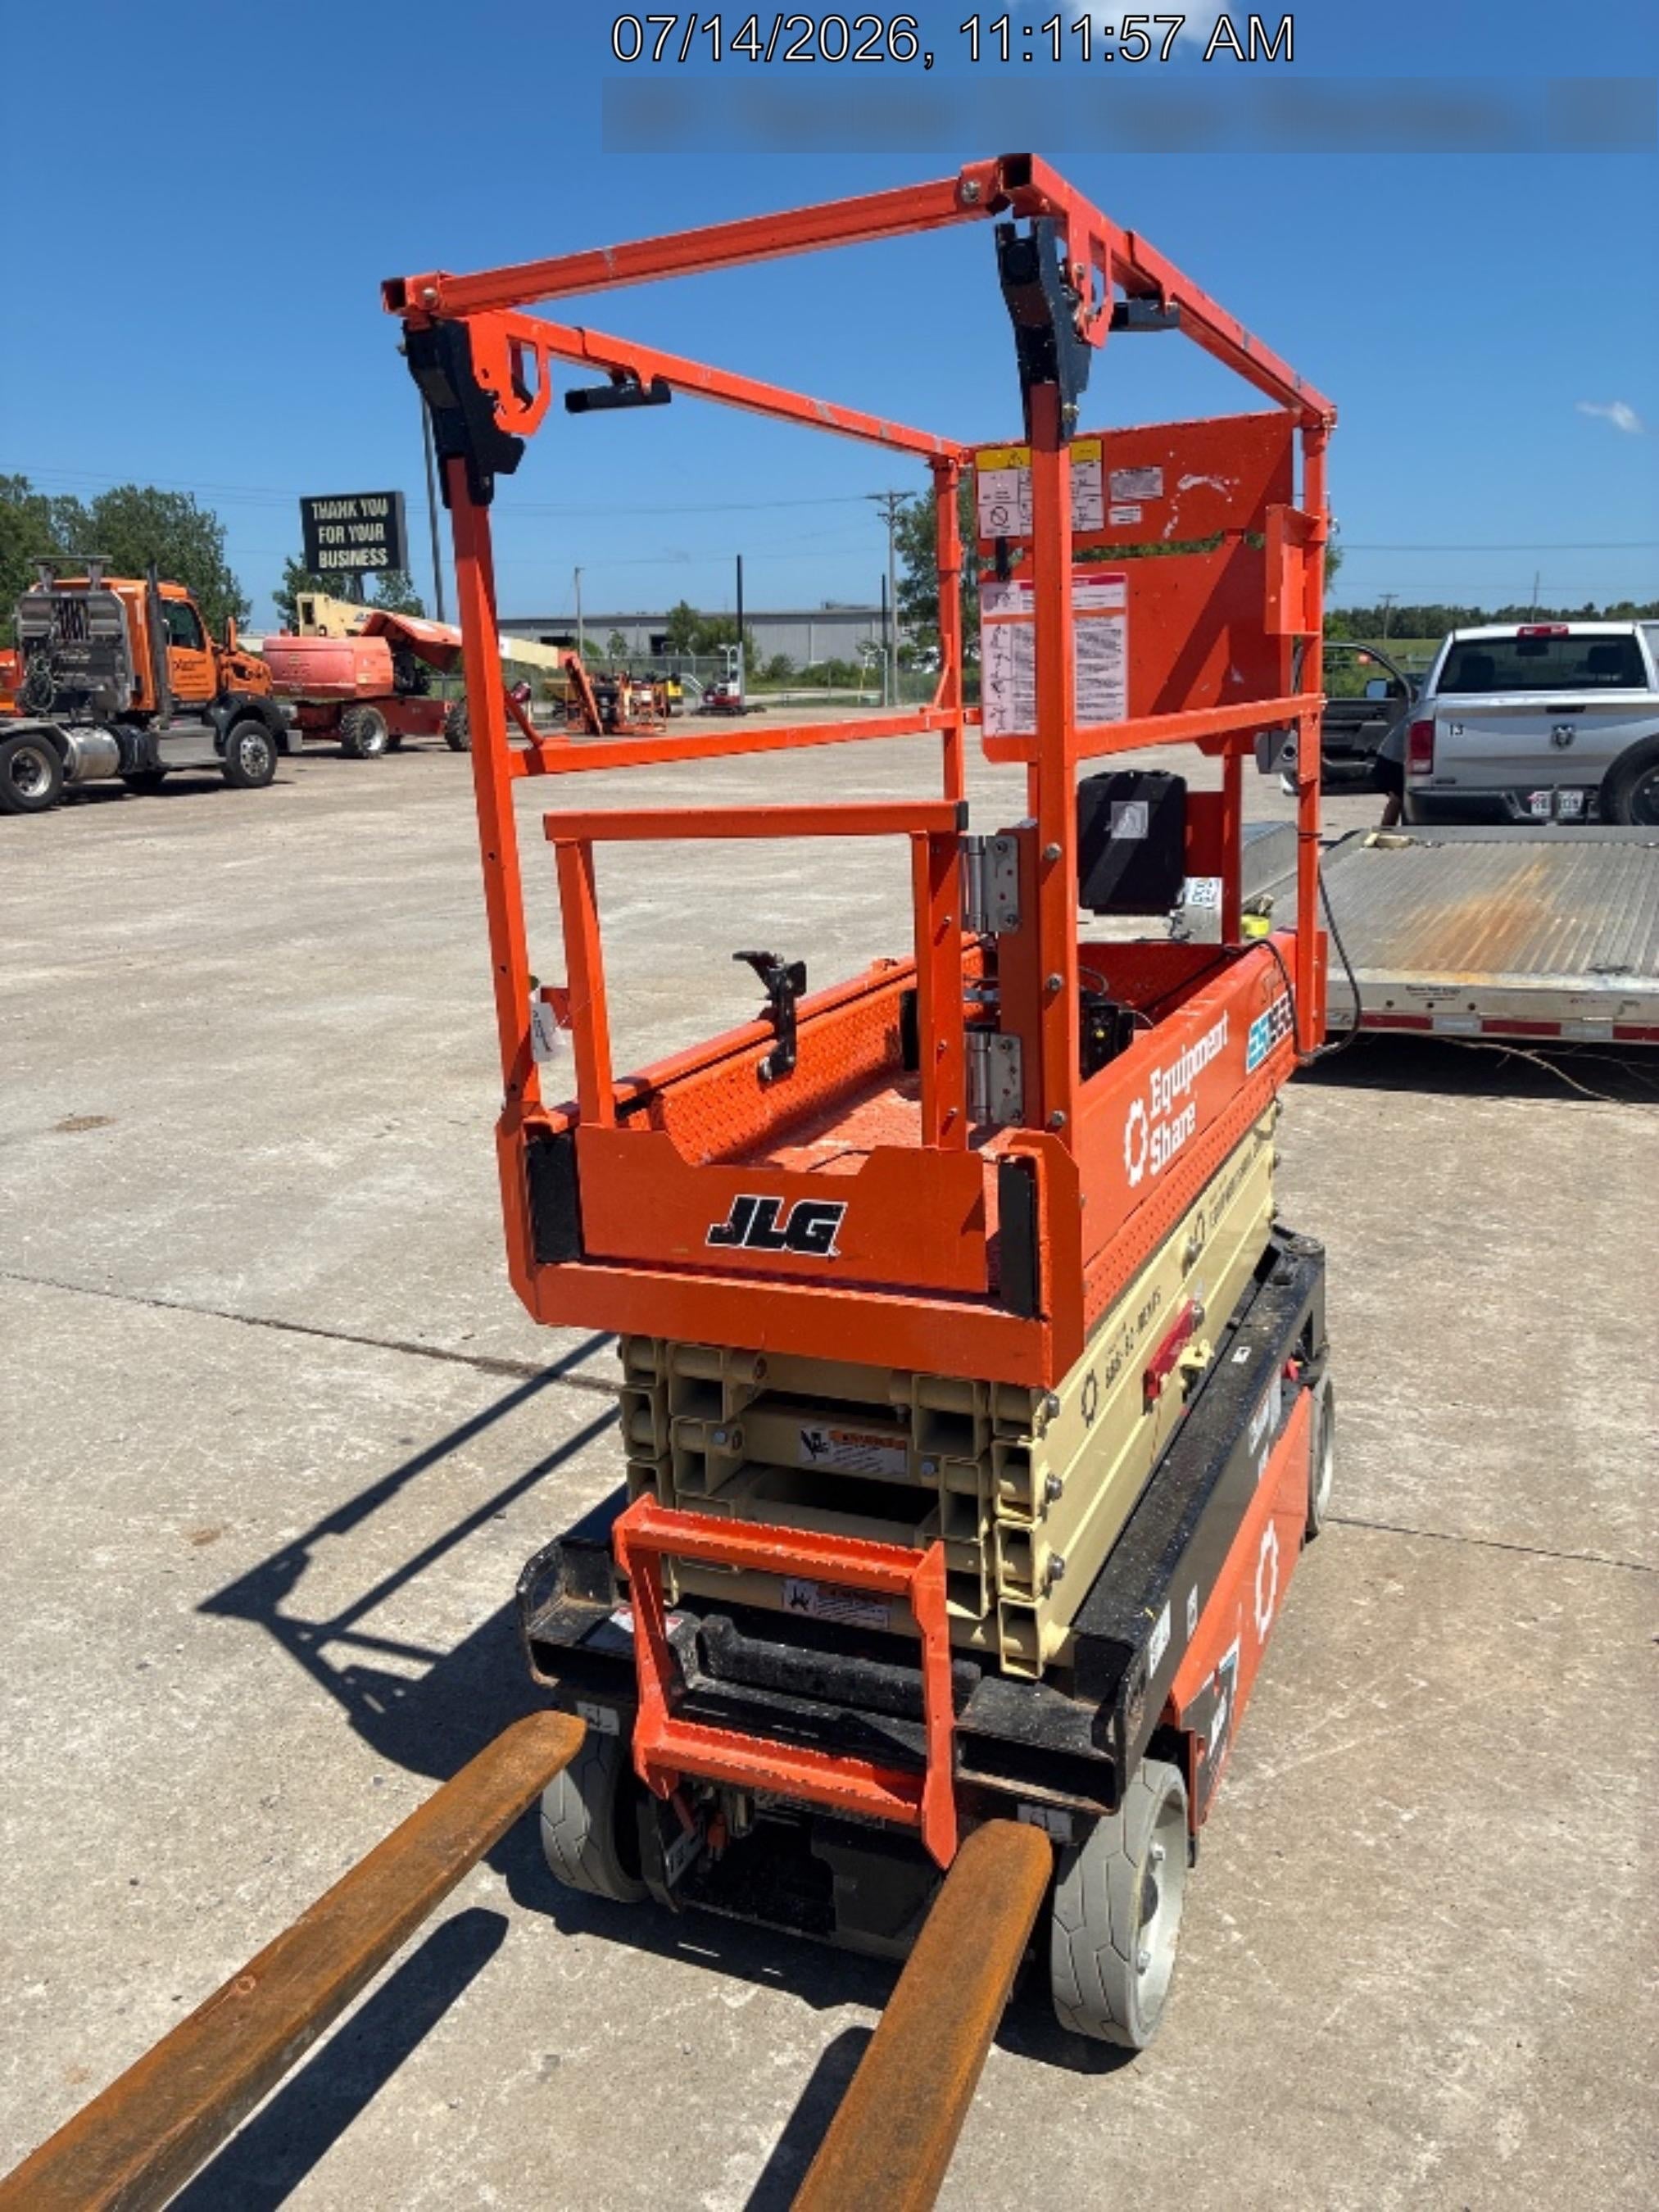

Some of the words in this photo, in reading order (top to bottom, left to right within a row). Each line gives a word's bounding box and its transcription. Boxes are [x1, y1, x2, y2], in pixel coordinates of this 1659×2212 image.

[311, 500, 357, 520] THANK
[360, 497, 389, 517] YOU
[318, 525, 345, 544] FOR
[348, 523, 386, 542] YOUR
[318, 546, 389, 569] BUSINESS
[1149, 1009, 1230, 1120] Equipment
[1149, 1100, 1197, 1176] Share
[705, 1194, 849, 1257] JLG
